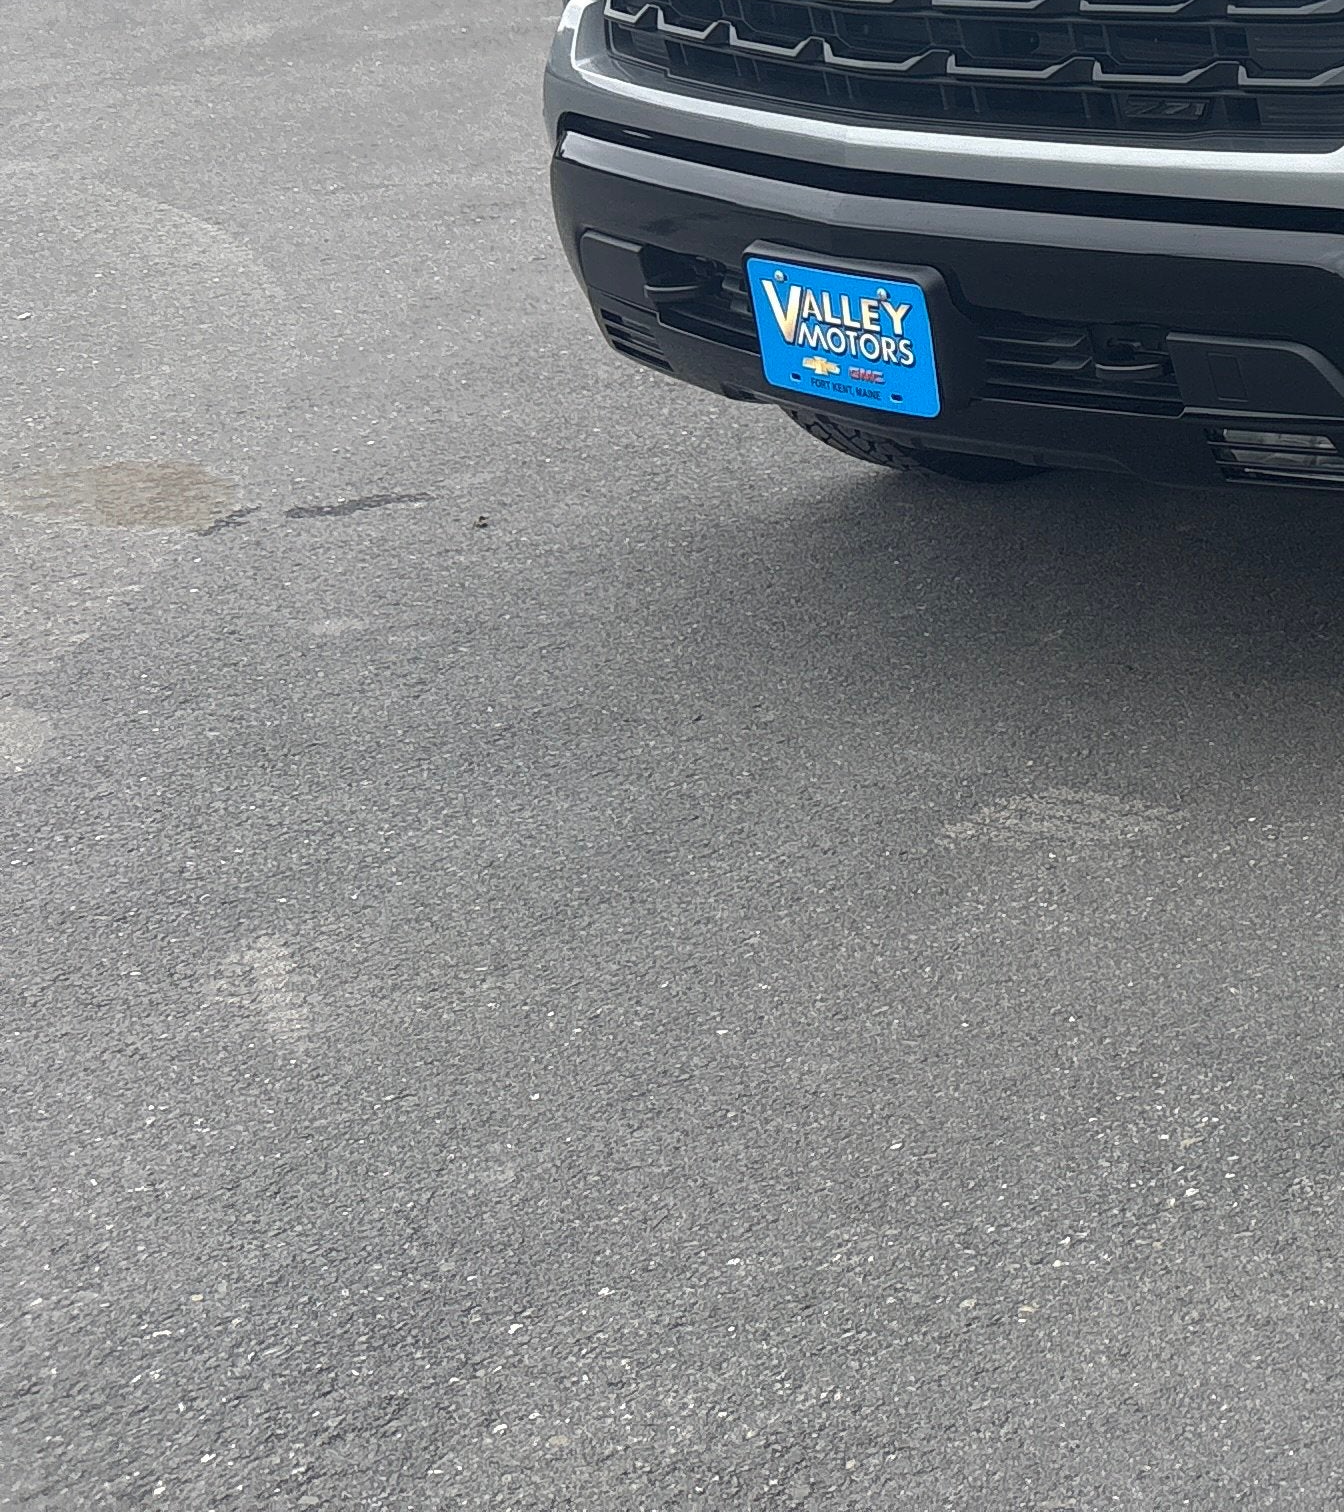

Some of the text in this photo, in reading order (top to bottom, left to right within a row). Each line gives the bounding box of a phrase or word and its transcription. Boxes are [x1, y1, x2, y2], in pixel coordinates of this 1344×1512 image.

[759, 277, 913, 345] VALLEY
[796, 321, 917, 368] MOTORS
[810, 376, 831, 390] FORT
[856, 387, 882, 400] MAINE
[847, 366, 886, 384] GMC
